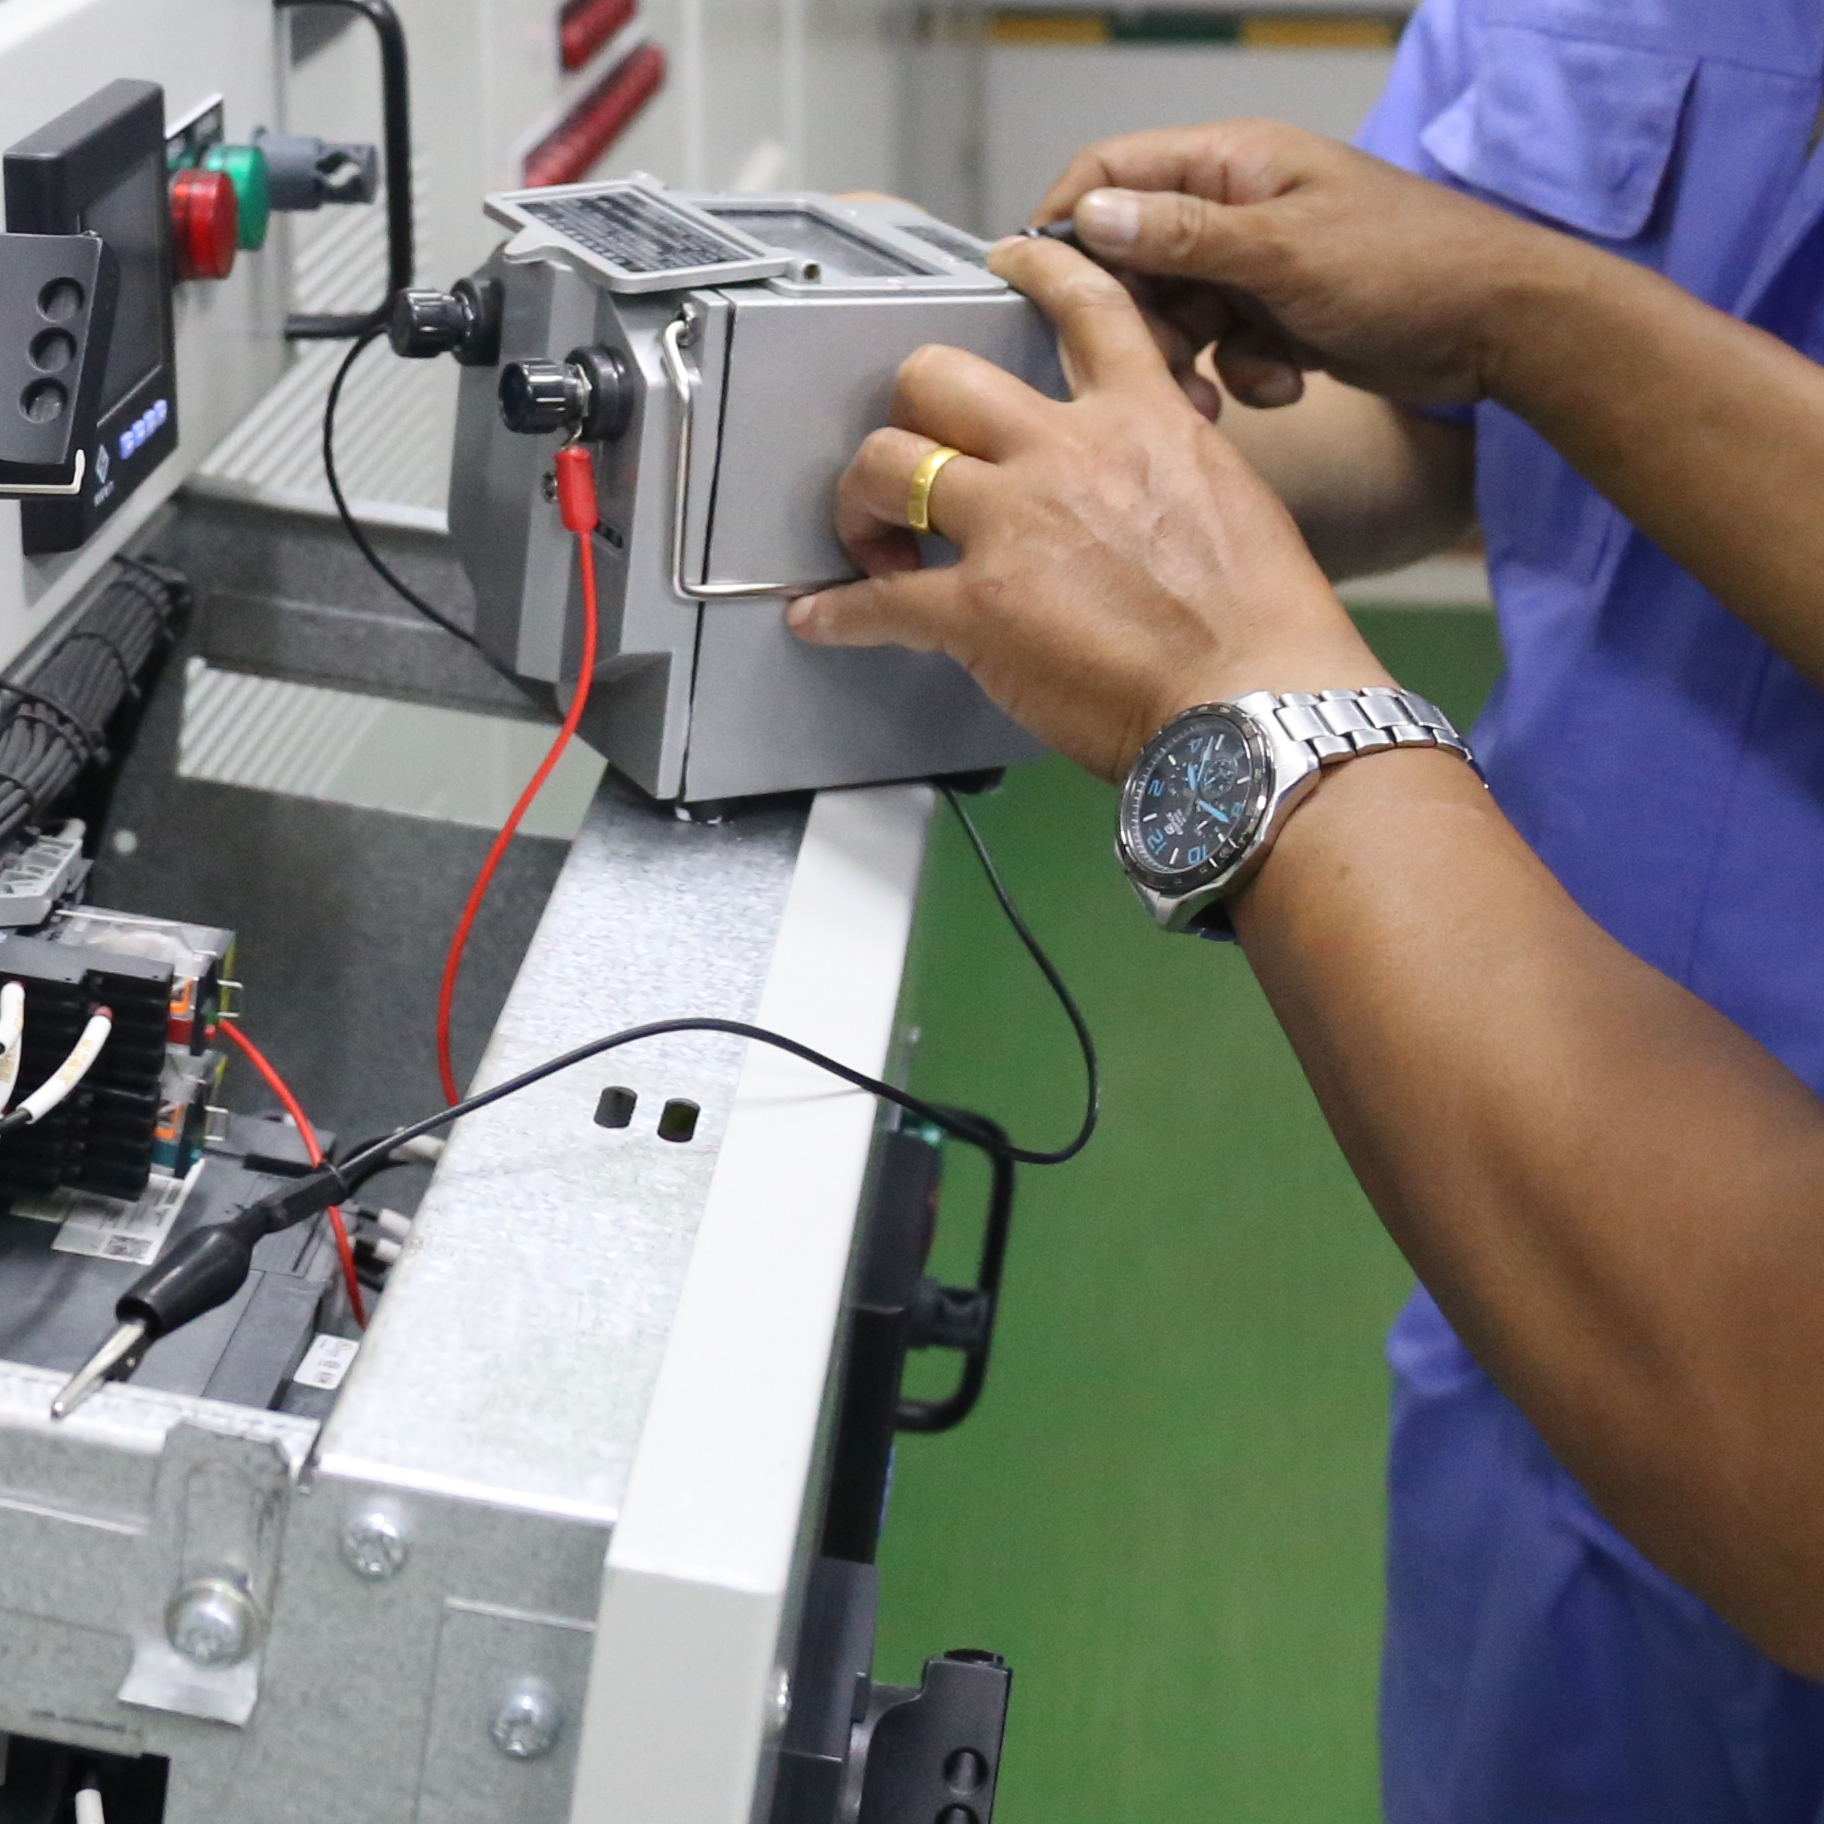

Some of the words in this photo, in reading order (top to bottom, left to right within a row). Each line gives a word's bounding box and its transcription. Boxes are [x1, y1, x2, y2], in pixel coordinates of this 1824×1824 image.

[1148, 779, 1166, 797] 2
[1146, 828, 1168, 856] 12
[1187, 844, 1209, 866] 10
